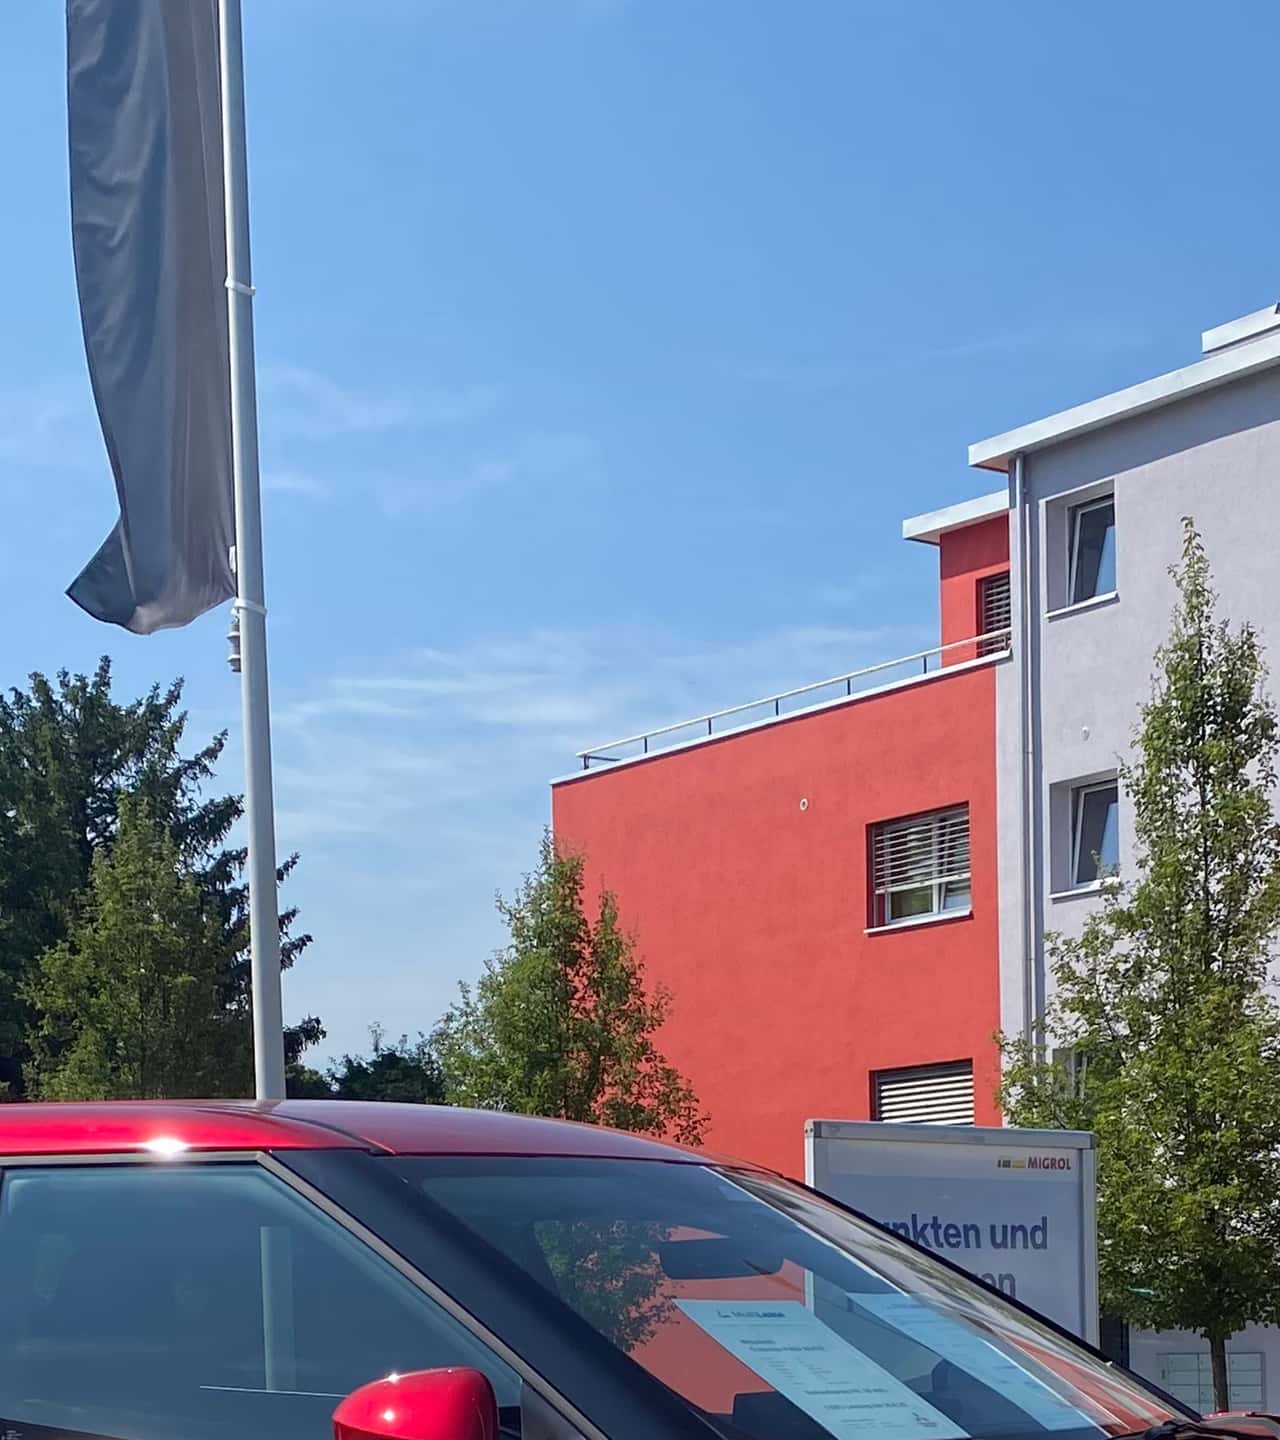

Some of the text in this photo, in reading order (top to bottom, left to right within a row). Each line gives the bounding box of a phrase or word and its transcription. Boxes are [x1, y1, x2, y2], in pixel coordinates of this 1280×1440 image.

[1027, 1156, 1072, 1170] MIGROL
[880, 1214, 1048, 1249] nkten und
